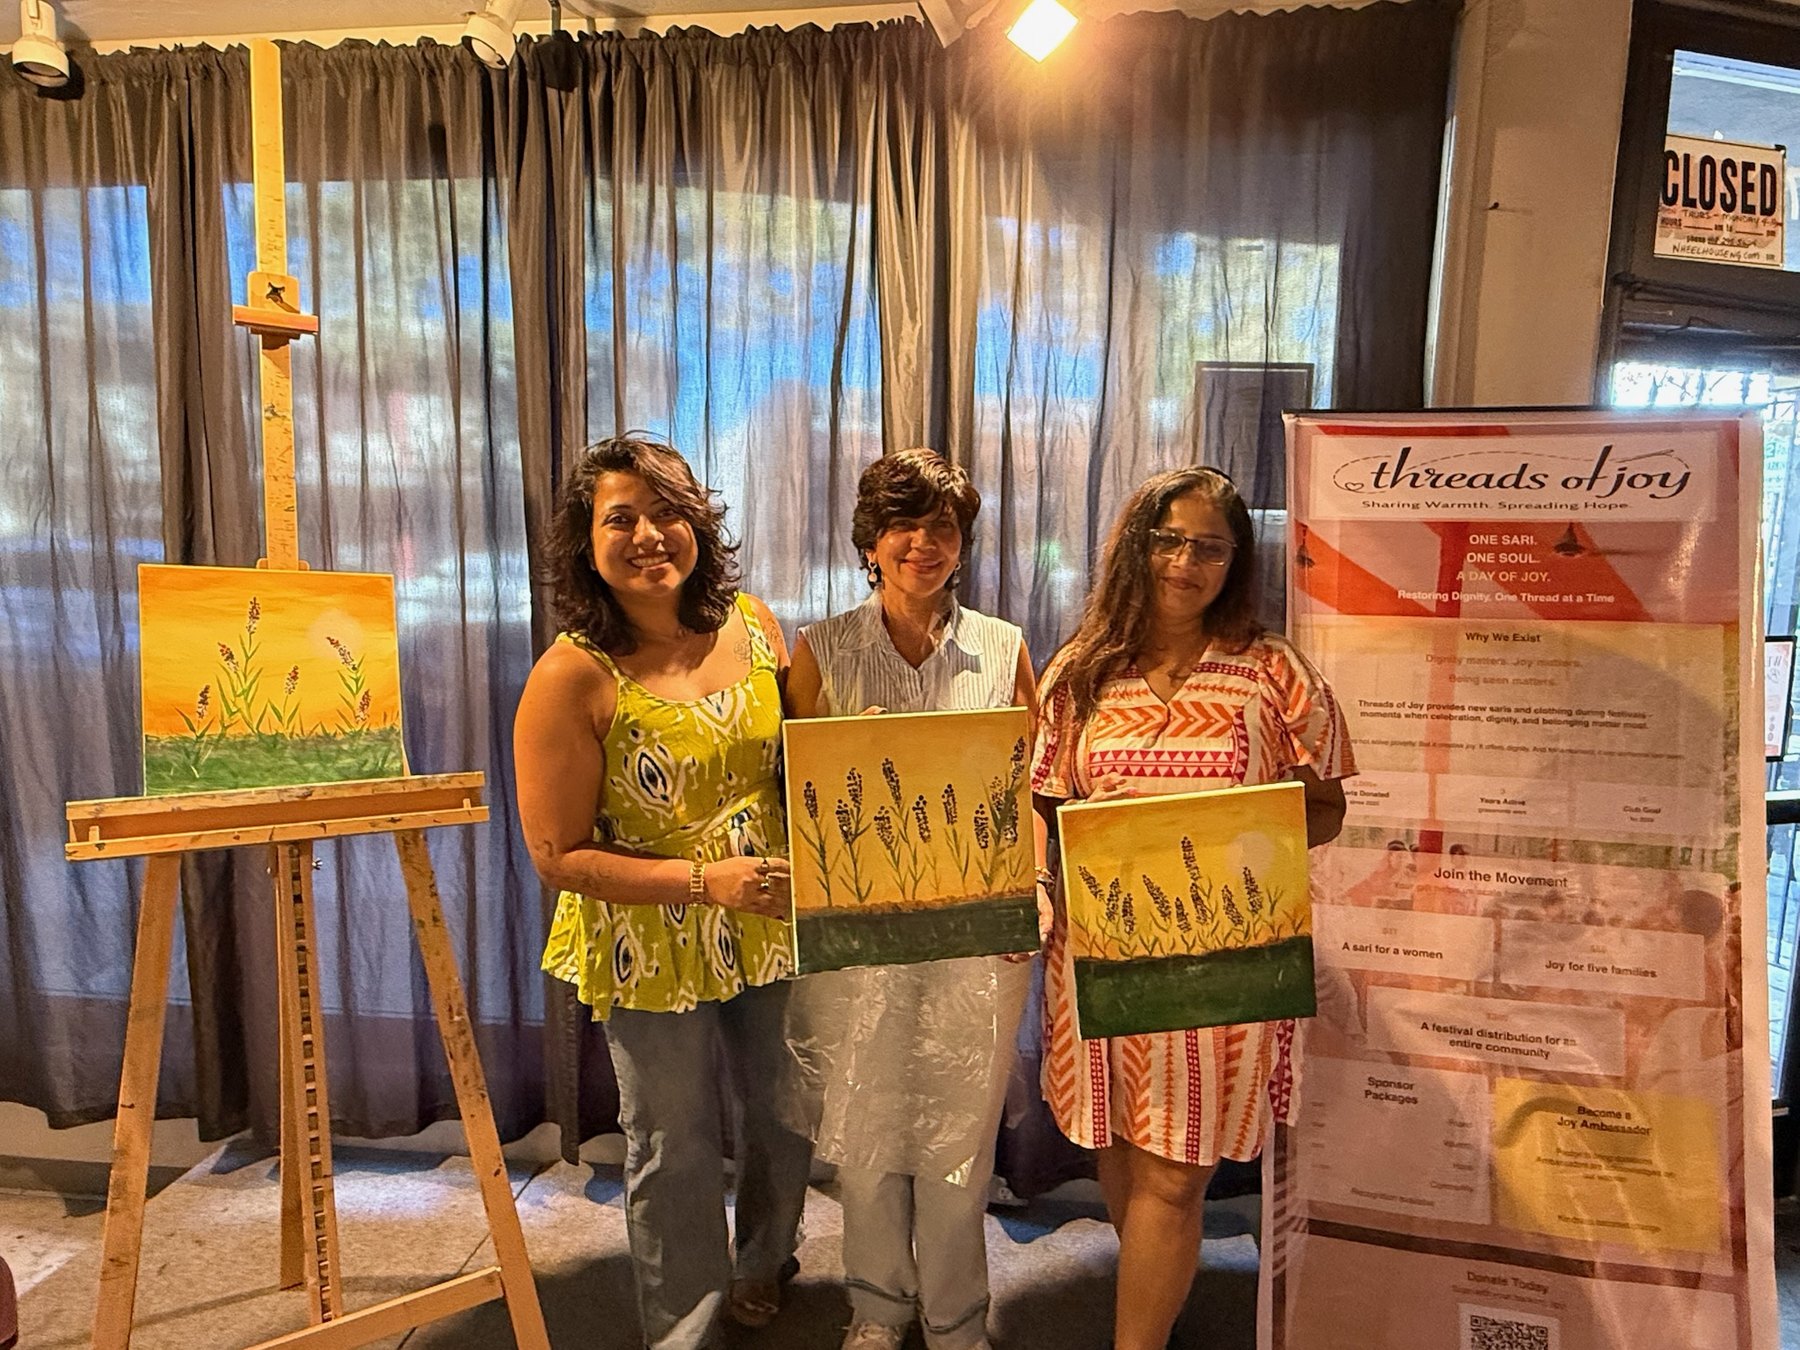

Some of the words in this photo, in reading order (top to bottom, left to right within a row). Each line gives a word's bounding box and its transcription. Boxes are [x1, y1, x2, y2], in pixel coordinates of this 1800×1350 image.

[1662, 150, 1777, 217] CLOSED
[1370, 446, 1549, 490] threads
[1561, 445, 1614, 491] of
[1595, 467, 1691, 500] joy
[1362, 500, 1420, 510] Sharing
[1498, 501, 1579, 511] Spreading
[1469, 534, 1498, 545] ONE
[1502, 534, 1537, 546] SARI.
[1466, 552, 1495, 563] ONE
[1499, 552, 1540, 564] SOUL.
[1456, 571, 1465, 581] A
[1469, 571, 1496, 581] DAY
[1499, 571, 1517, 582] OF
[1521, 571, 1551, 582] JOY.
[1398, 590, 1449, 602] Restoring
[1495, 592, 1517, 602] One
[1520, 592, 1559, 602] Thread
[1562, 594, 1573, 603] at
[1576, 595, 1583, 603] a
[1586, 593, 1615, 603] Time
[1465, 632, 1489, 643] Why
[1493, 633, 1510, 642] We
[1512, 633, 1541, 642] Exist
[1513, 658, 1533, 668] Joy
[1358, 700, 1394, 708] Threads
[1407, 701, 1424, 711] Joy
[1426, 702, 1465, 712] provides
[1489, 704, 1512, 713] saris
[1534, 707, 1573, 717] clothing
[1575, 709, 1605, 717] during
[1360, 710, 1402, 718] moments
[1404, 711, 1428, 719] when
[1430, 712, 1483, 723] celebration,
[1486, 714, 1520, 725] dignity,
[1522, 717, 1539, 725] and
[1542, 718, 1589, 728] belonging
[1592, 720, 1621, 728] matter
[1359, 790, 1390, 798] Donated
[1433, 867, 1464, 880] Join
[1468, 869, 1491, 882] the
[1496, 872, 1568, 888] Movement
[1342, 942, 1350, 951] A
[1352, 943, 1372, 953] sari
[1375, 944, 1390, 954] for
[1393, 947, 1400, 955] a
[1402, 948, 1443, 960] women
[1545, 960, 1565, 972] Joy
[1568, 961, 1585, 972] for
[1587, 962, 1608, 974] five
[1611, 964, 1658, 978] families
[1420, 1022, 1430, 1031] A
[1432, 1022, 1473, 1037] festival
[1476, 1028, 1542, 1045] distribution
[1545, 1034, 1561, 1046] for
[1449, 1038, 1483, 1050] entire
[1485, 1042, 1551, 1060] community
[1367, 1076, 1416, 1091] Sponsor
[1364, 1089, 1419, 1105] Packages
[1577, 1105, 1622, 1120] Become
[1557, 1116, 1577, 1129] Joy
[1580, 1119, 1653, 1136] Ambassador
[1511, 1276, 1550, 1294] Today
